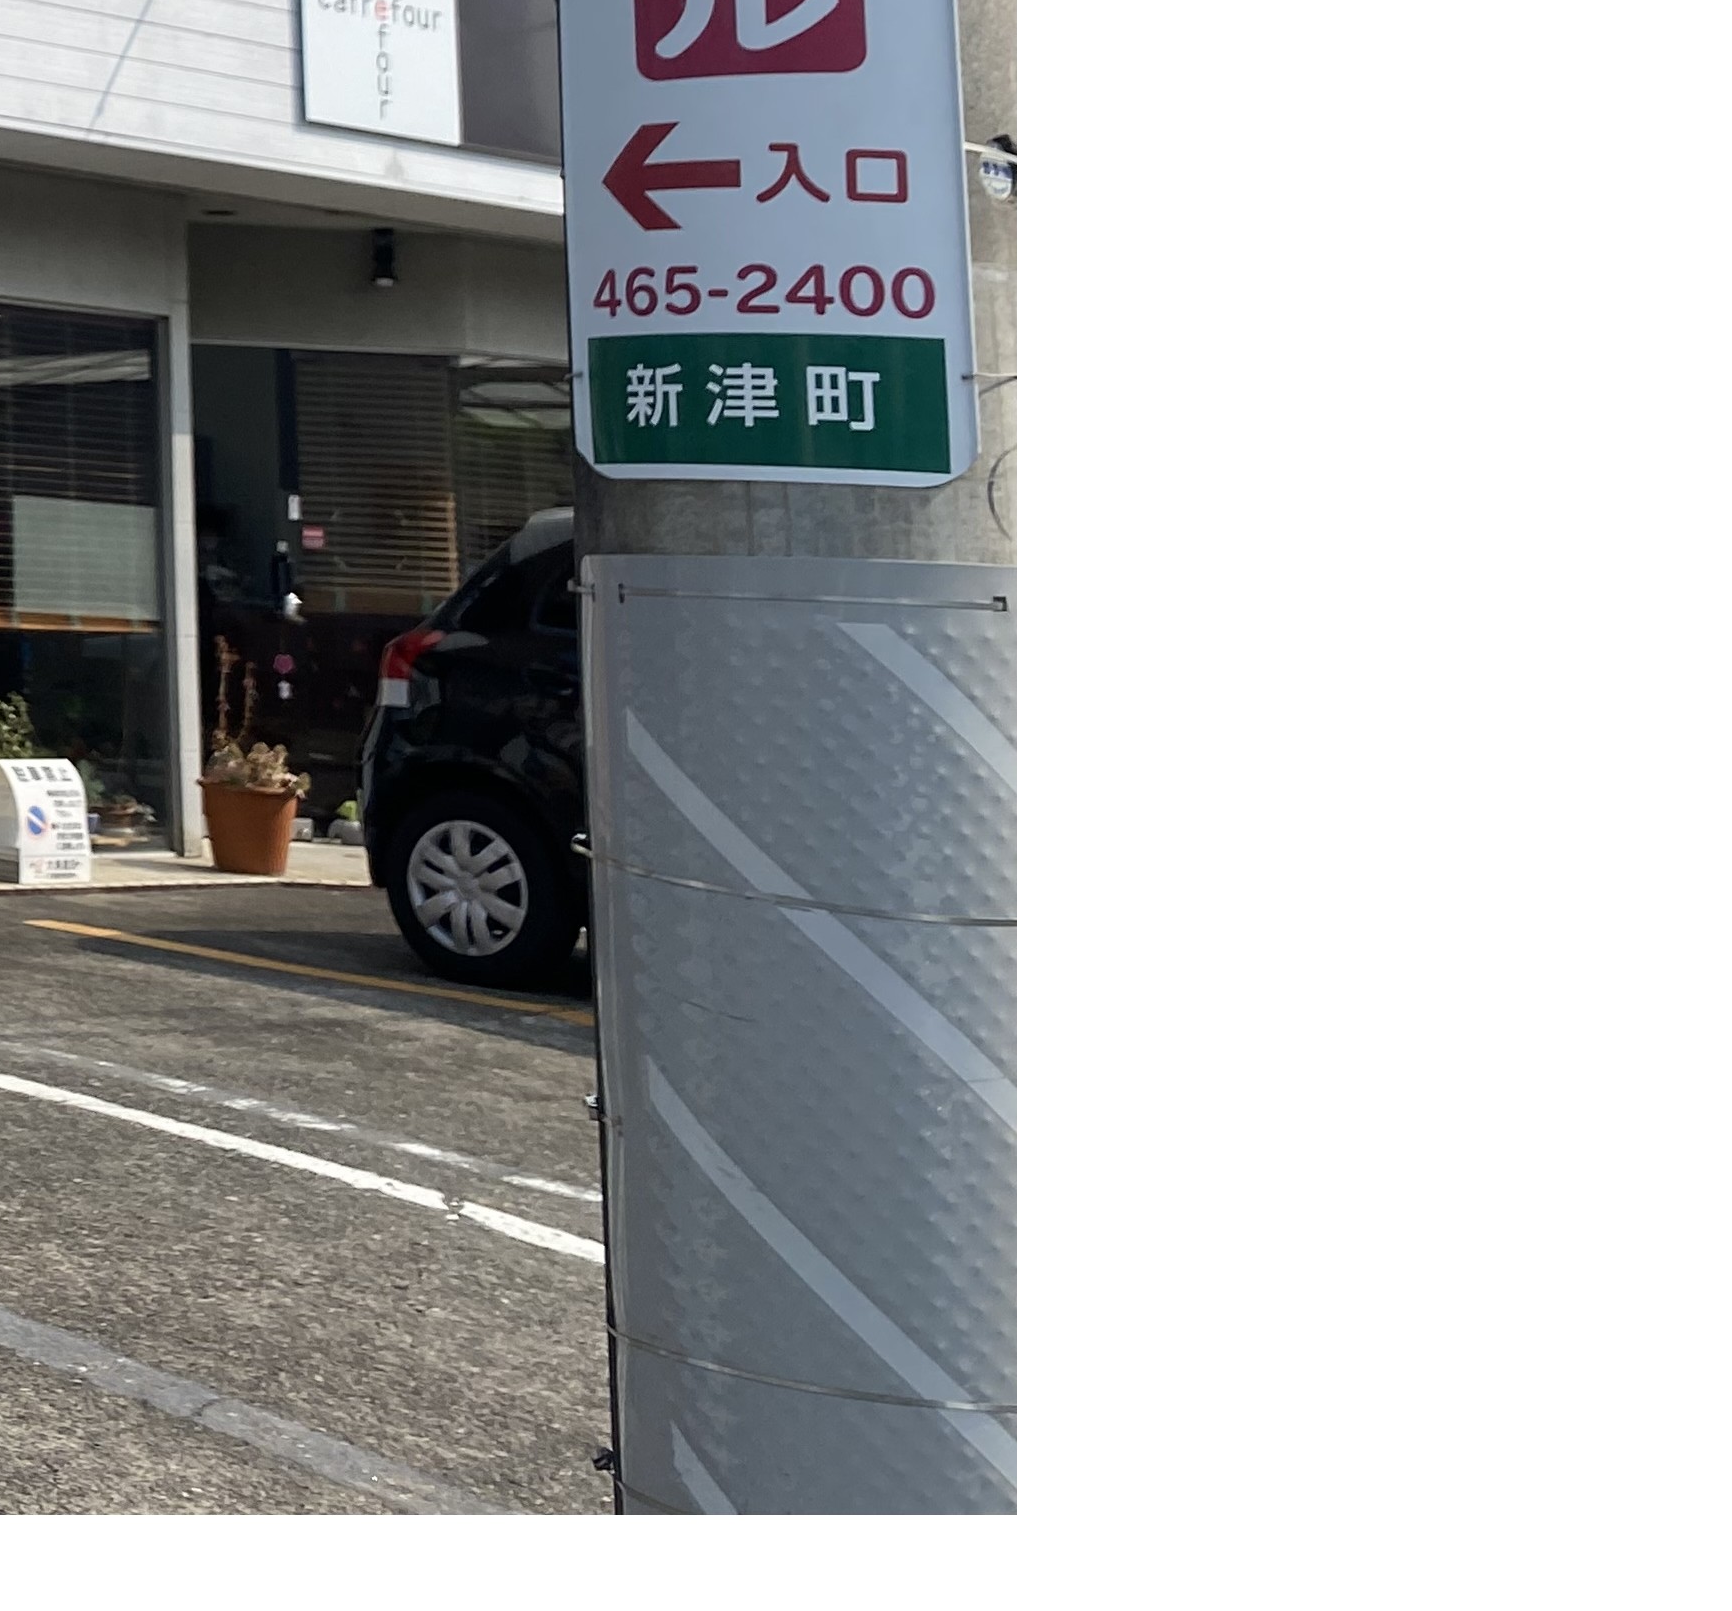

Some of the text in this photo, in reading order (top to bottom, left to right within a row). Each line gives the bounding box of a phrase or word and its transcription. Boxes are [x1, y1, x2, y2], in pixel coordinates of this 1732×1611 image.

[755, 143, 908, 203] 入口
[592, 263, 936, 319] 465-2400
[626, 362, 881, 431] 新津町
